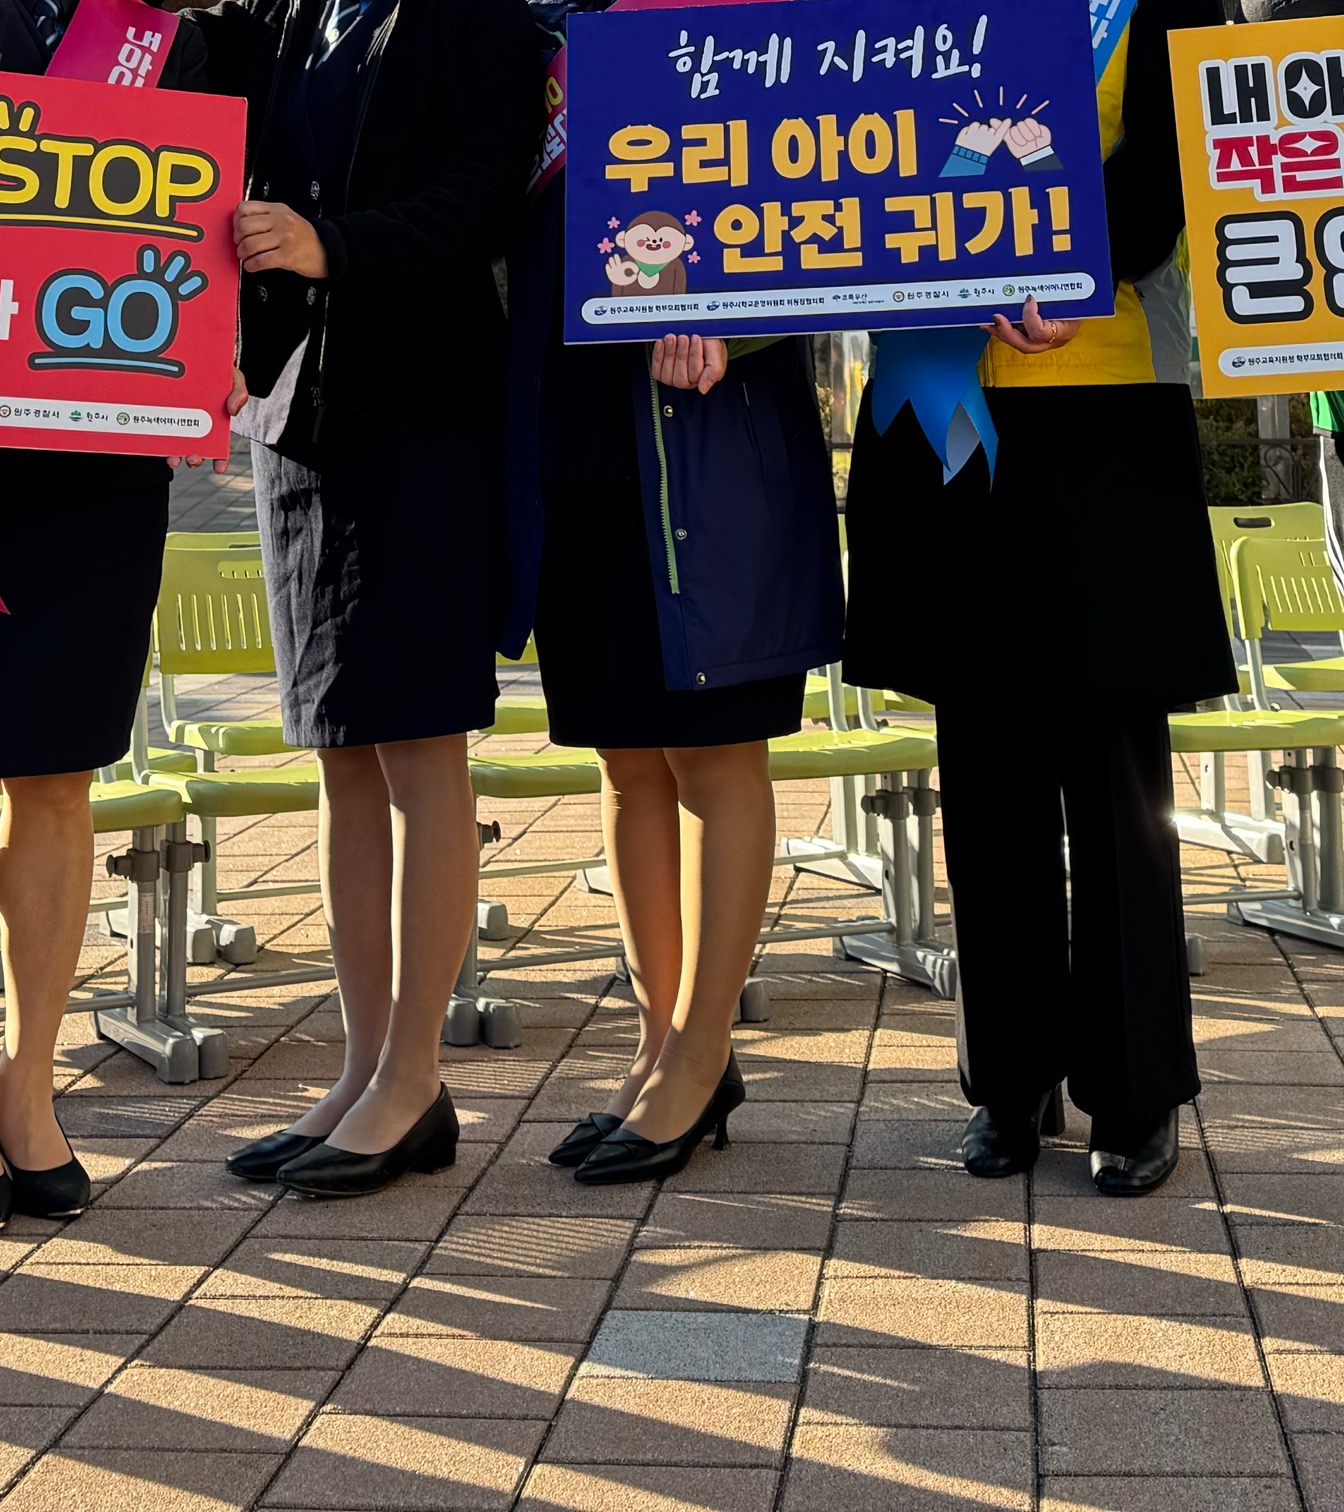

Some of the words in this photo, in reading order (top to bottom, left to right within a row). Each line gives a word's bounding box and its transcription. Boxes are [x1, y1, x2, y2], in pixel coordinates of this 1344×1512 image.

[669, 30, 793, 100] 함께
[816, 14, 989, 83] 지켜요!
[1205, 62, 1270, 126] 내
[605, 119, 749, 193] 우리
[771, 108, 918, 182] 아이
[1212, 128, 1343, 195] 작은
[713, 197, 863, 274] 안전
[884, 186, 1072, 264] 귀가!
[1223, 218, 1306, 316] 큰
[41, 274, 174, 353] GO
